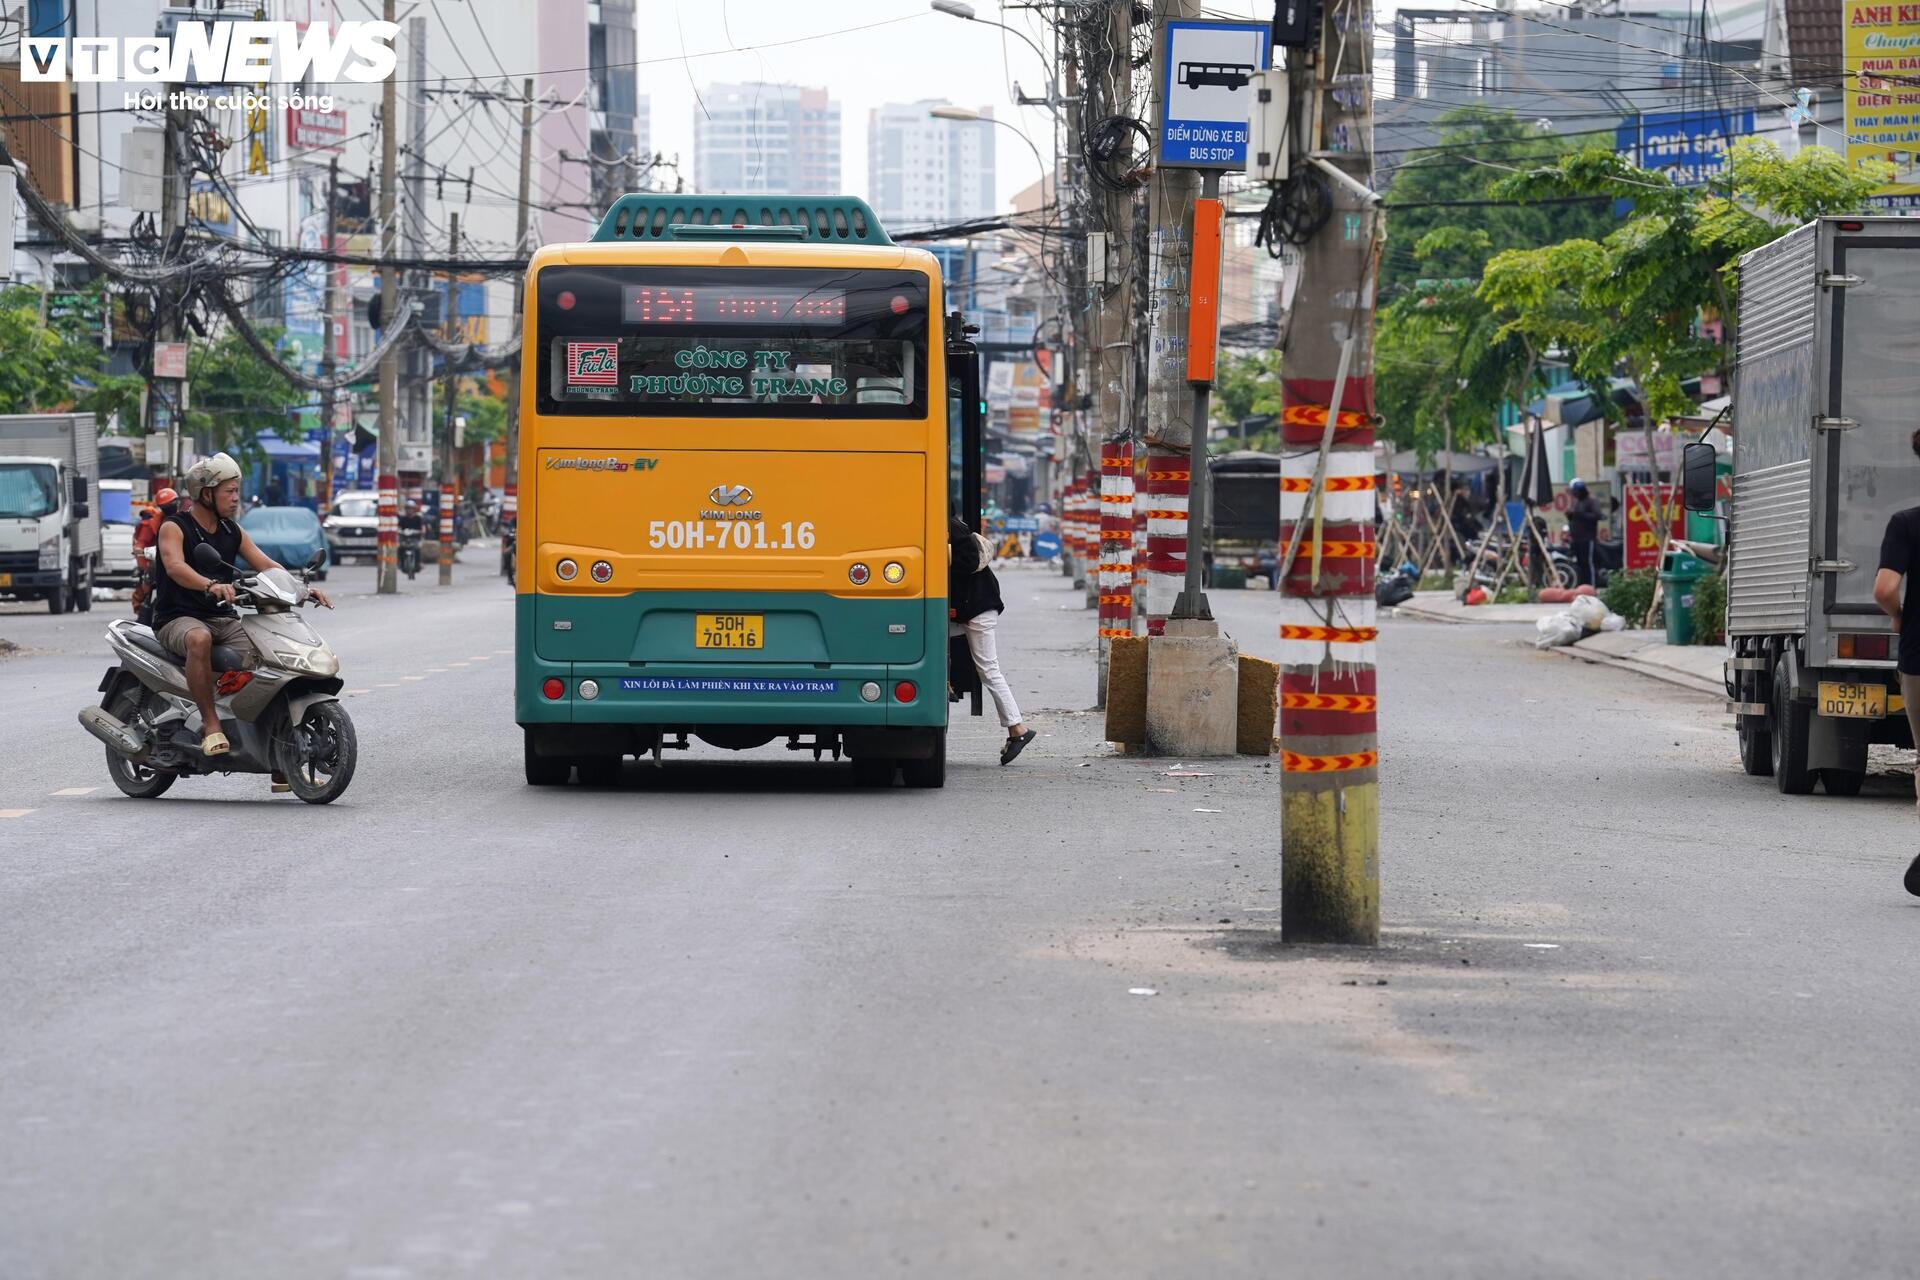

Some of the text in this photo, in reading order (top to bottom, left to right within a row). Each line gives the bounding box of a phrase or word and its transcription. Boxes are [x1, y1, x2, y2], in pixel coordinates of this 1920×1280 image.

[1851, 6, 1892, 26] ANH
[1862, 56, 1920, 70] MUA BÁ
[1167, 123, 1248, 143] ĐIỂM DỪNG XE BU
[1189, 147, 1234, 160] BUS STOP
[675, 345, 790, 369] CÔNG TY
[630, 372, 848, 397] PHƯƠNG TRANG
[700, 510, 762, 521] KIM LONG
[649, 521, 815, 550] 50H-701.16
[716, 616, 744, 631] 50H
[704, 632, 756, 646] 701.16
[623, 680, 641, 689] XIN
[643, 679, 660, 689] LỖI
[662, 679, 675, 689] ĐÃ
[678, 679, 699, 689] LÀM
[733, 682, 751, 690] KHI
[753, 682, 766, 690] XE
[768, 682, 781, 690] RA
[783, 681, 804, 691] VÀO
[806, 682, 834, 692] TRẠM
[1838, 684, 1867, 699] 93H
[1826, 700, 1878, 715] 007.14
